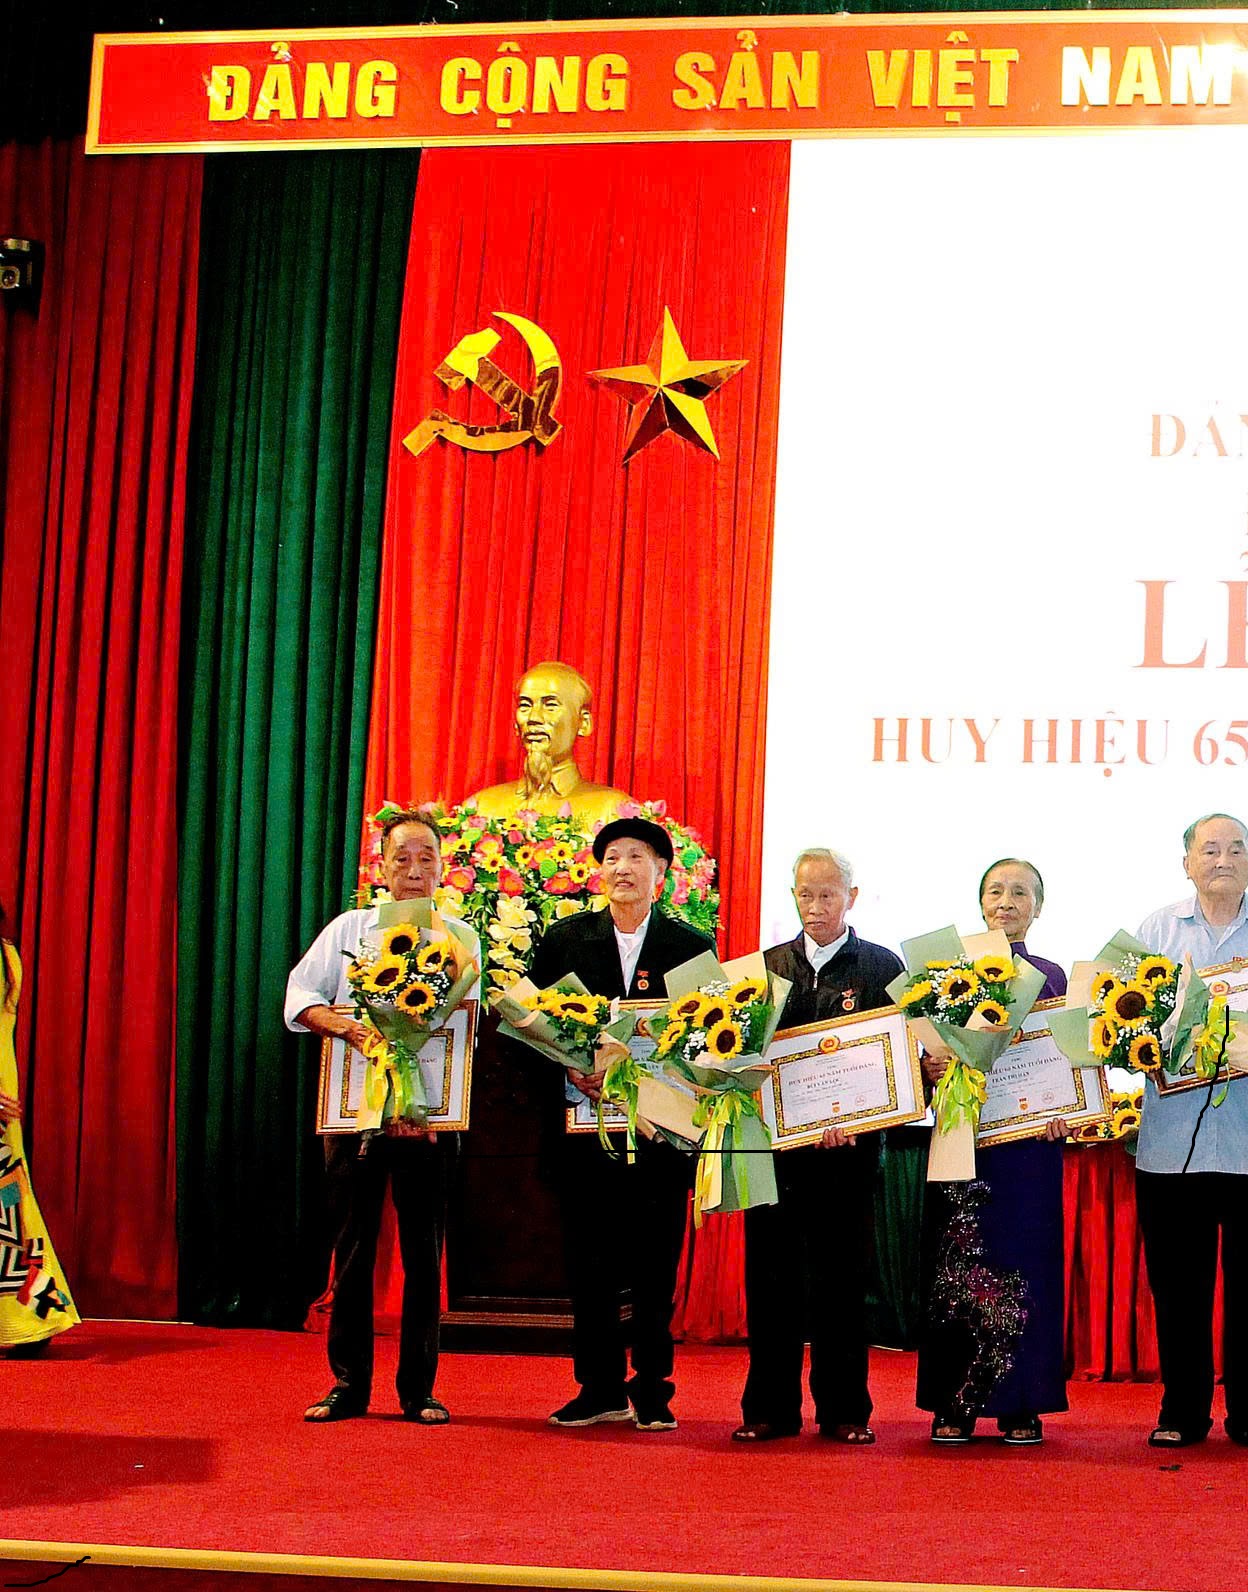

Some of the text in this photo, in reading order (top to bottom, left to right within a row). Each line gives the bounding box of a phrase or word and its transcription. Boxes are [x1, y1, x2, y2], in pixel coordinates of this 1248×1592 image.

[207, 42, 398, 122] ĐẢNG
[440, 41, 628, 129] CỘNG
[673, 30, 820, 112] SẢN
[866, 30, 1019, 123] VIỆT
[1060, 45, 1233, 107] NAM
[872, 717, 1002, 765] HUY
[1021, 711, 1171, 779] HIỆU
